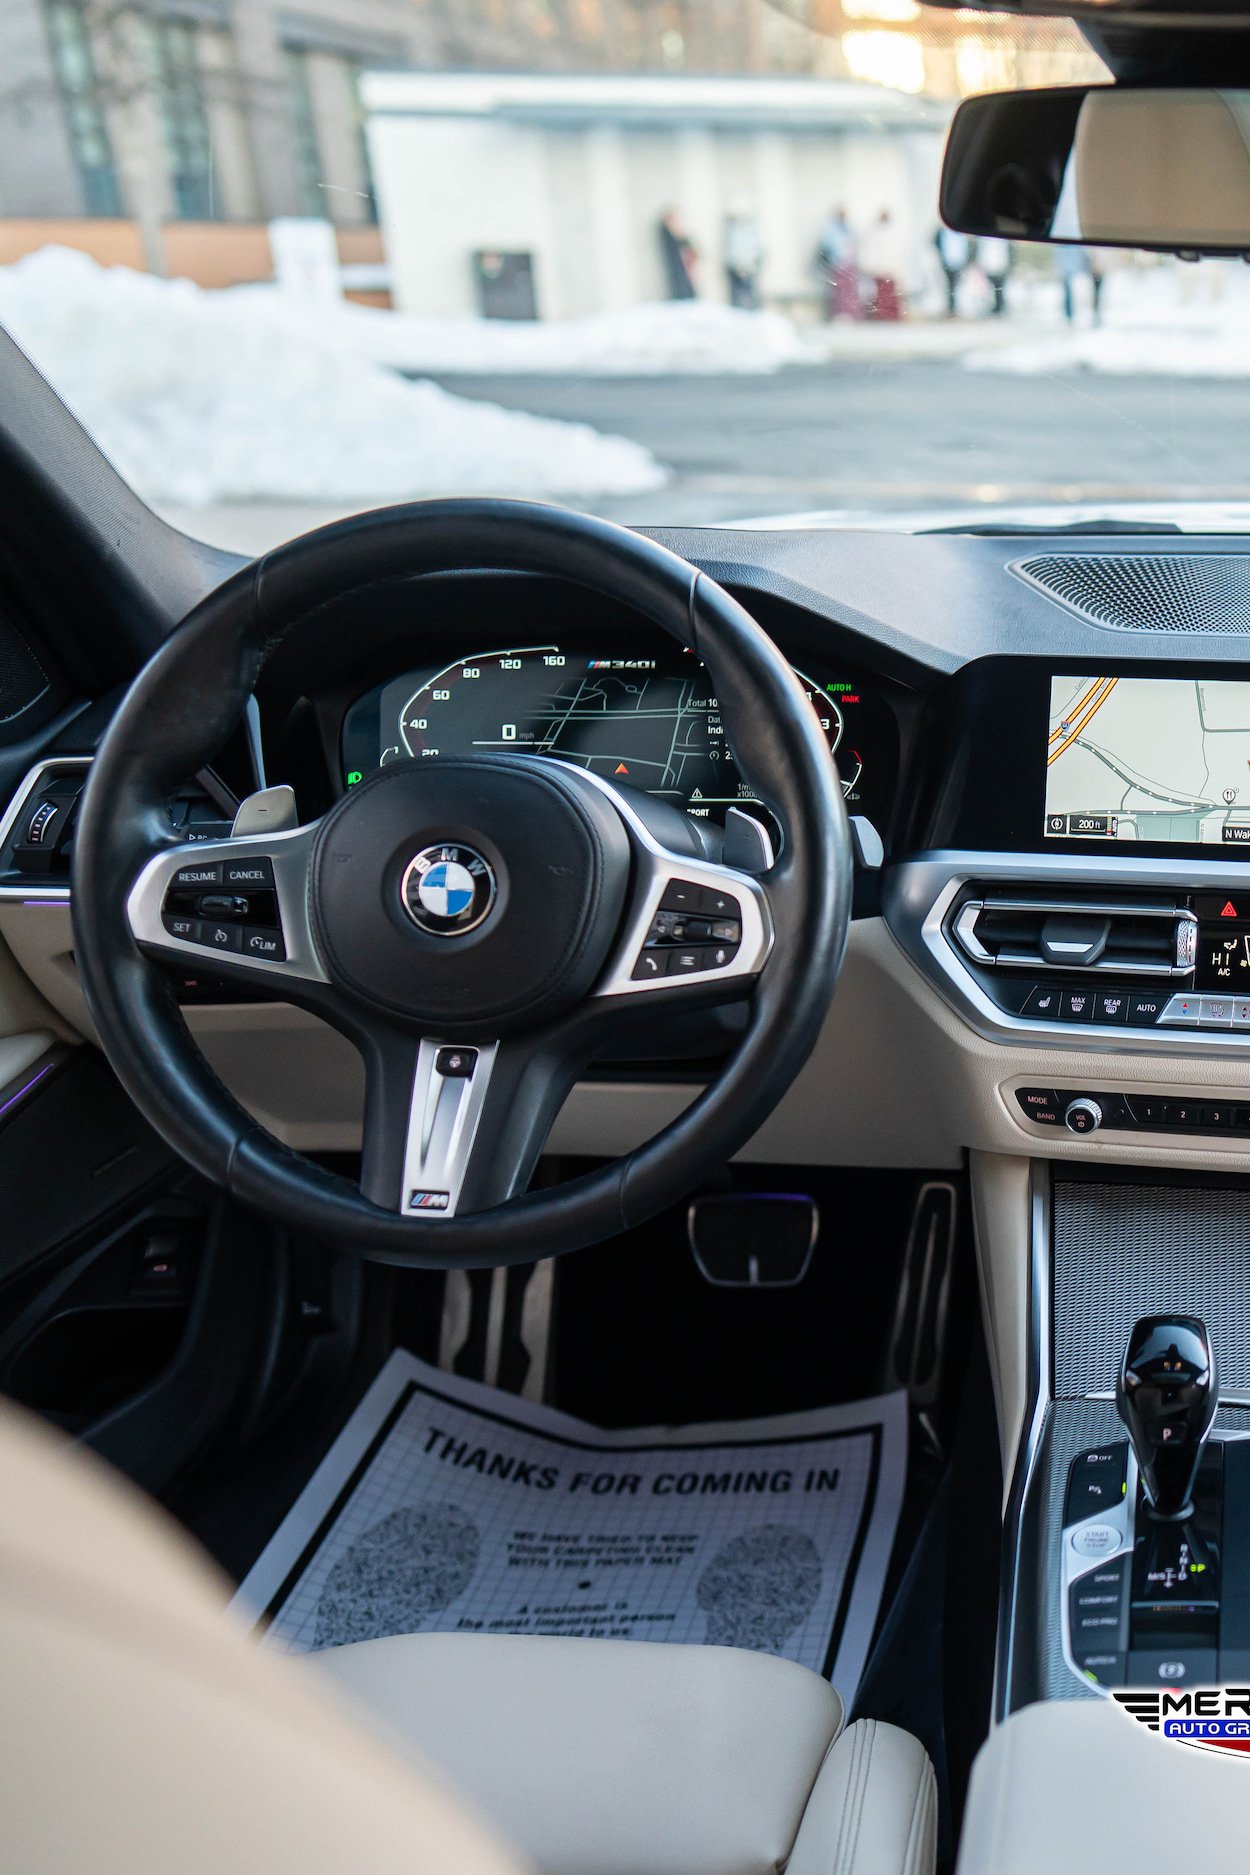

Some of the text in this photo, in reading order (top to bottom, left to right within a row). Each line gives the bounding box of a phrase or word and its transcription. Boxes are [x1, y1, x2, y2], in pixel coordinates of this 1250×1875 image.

[499, 659, 522, 670] 120
[542, 655, 566, 667] 160
[588, 659, 656, 669] M340i
[462, 668, 480, 679] 80
[826, 684, 845, 692] AUTO
[432, 690, 450, 701] 60
[841, 695, 860, 703] PARK
[687, 699, 707, 707] Total
[409, 719, 428, 730] 40
[820, 719, 830, 730] 3
[502, 724, 535, 741] 0 mph
[1078, 819, 1101, 829] 200 ft
[1225, 829, 1232, 838] N
[413, 847, 487, 876] BMW
[178, 871, 217, 882] RESUME
[229, 870, 265, 880] CANCEL
[173, 922, 191, 932] SET
[259, 941, 276, 951] LIM
[1217, 967, 1231, 977] A/C
[1070, 996, 1086, 1004] MAX
[1103, 998, 1121, 1007] REAR
[1136, 1003, 1157, 1013] AUTO
[1027, 1095, 1048, 1105] MODE
[1036, 1111, 1056, 1121] BAND
[1180, 1110, 1186, 1119] 2
[1214, 1112, 1220, 1121] 3
[1163, 1427, 1171, 1440] P
[423, 1426, 840, 1495] THANKS FOR COMING IN
[1098, 1454, 1113, 1462] OFF
